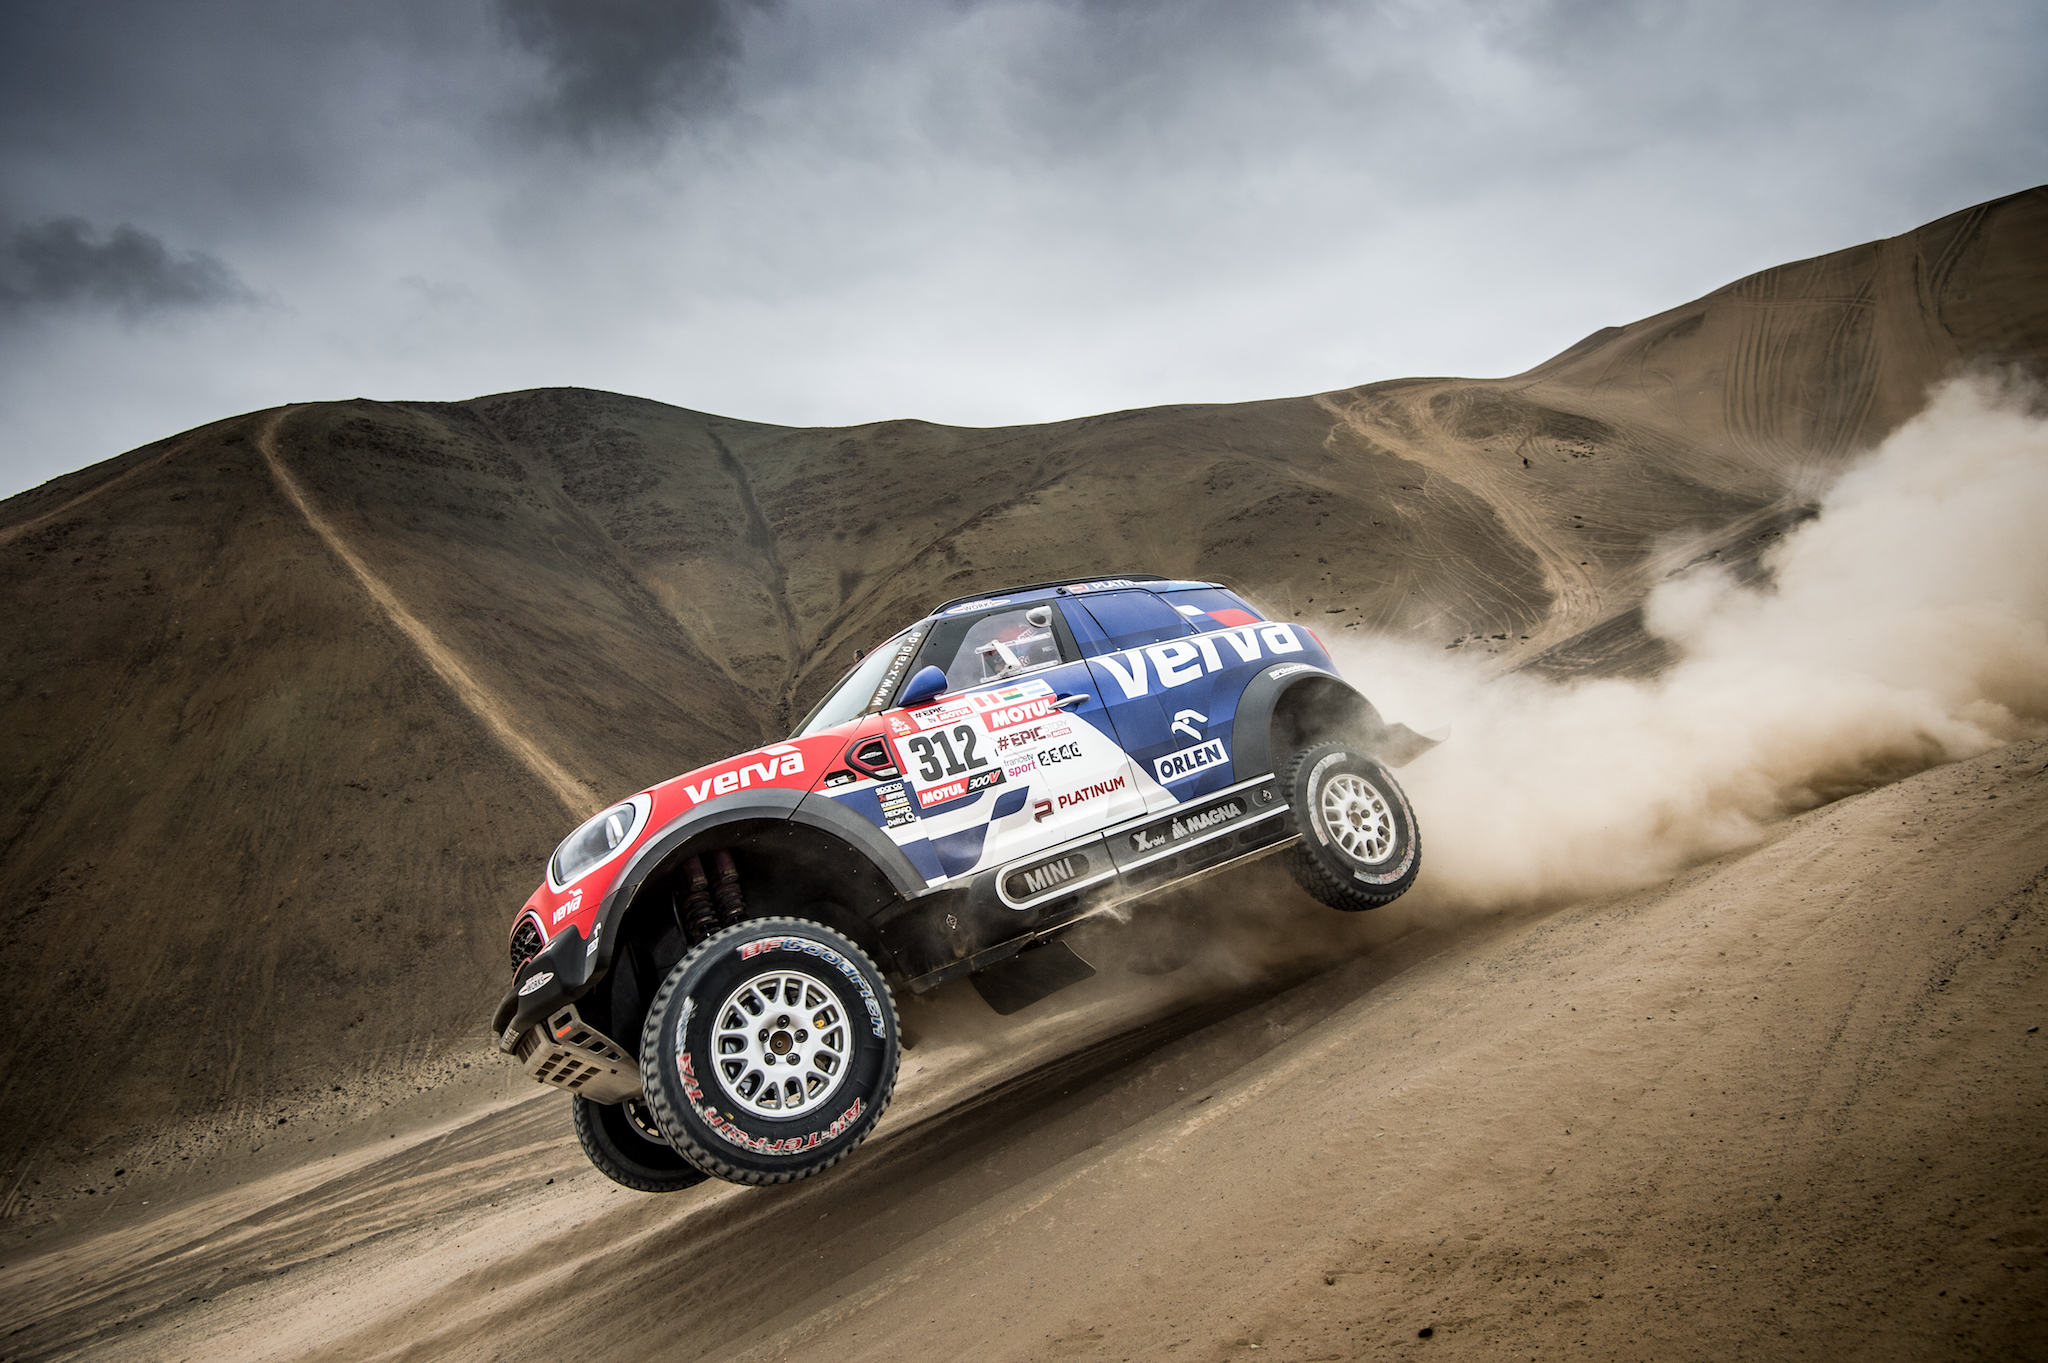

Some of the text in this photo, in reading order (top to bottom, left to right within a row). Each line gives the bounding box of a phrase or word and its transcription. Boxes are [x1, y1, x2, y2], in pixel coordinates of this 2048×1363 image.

[962, 602, 995, 611] WORKS
[872, 632, 921, 706] www.x-raid.de
[1093, 622, 1304, 699] verva
[940, 707, 972, 721] MOTUL
[990, 698, 1057, 729] MOTUL
[908, 724, 988, 782] 312
[1008, 760, 1037, 777] sport
[1160, 743, 1223, 778] ORLEN
[684, 749, 805, 804] verva
[921, 782, 966, 805] MOTUL
[968, 770, 1000, 790] 300V
[1058, 776, 1126, 809] PLATINUM
[1185, 803, 1242, 833] MAGNA
[1024, 857, 1076, 893] MINI
[552, 889, 583, 925] verva
[527, 976, 545, 992] WORKS
[738, 937, 887, 1039] BFGoodrich
